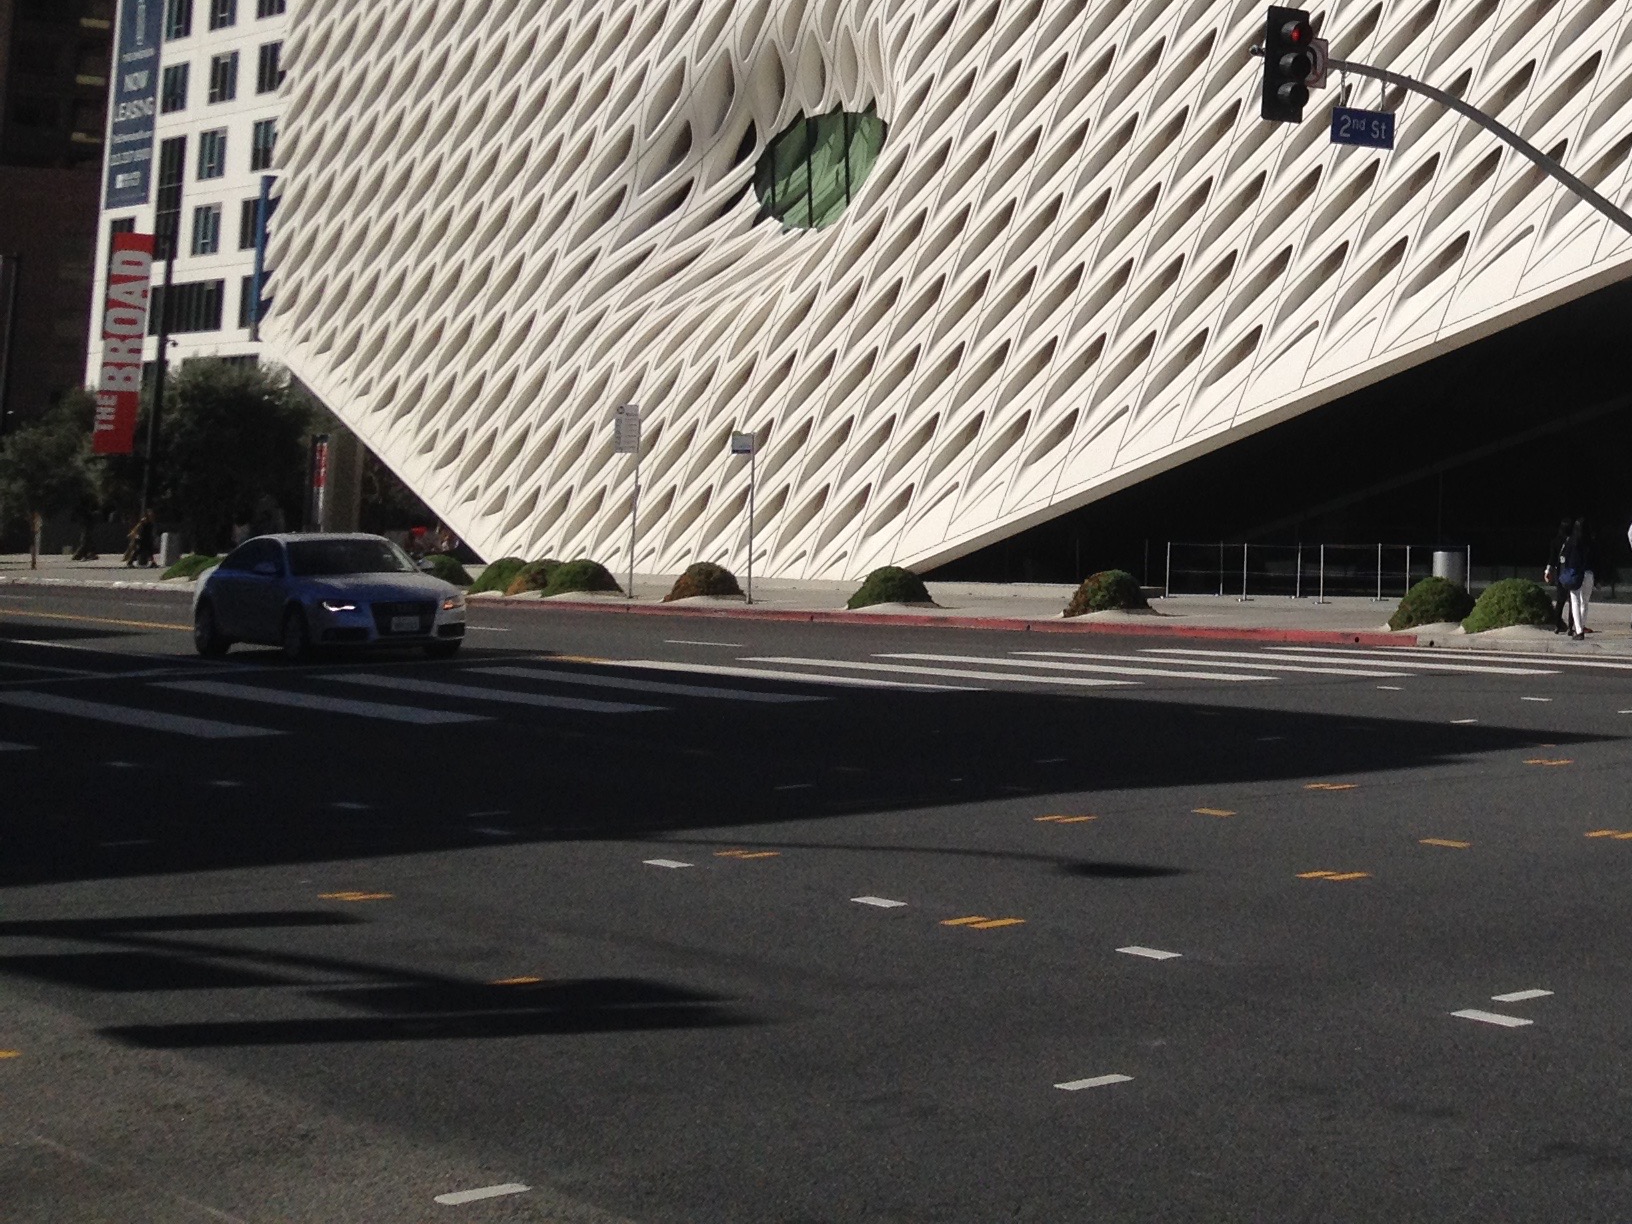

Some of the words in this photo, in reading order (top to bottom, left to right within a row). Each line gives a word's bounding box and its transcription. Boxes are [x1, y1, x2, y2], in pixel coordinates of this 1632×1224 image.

[115, 96, 154, 123] LEASING
[1339, 114, 1366, 138] 2nd
[1370, 120, 1387, 139] St
[103, 249, 154, 394] BROAD
[93, 392, 117, 432] THE
